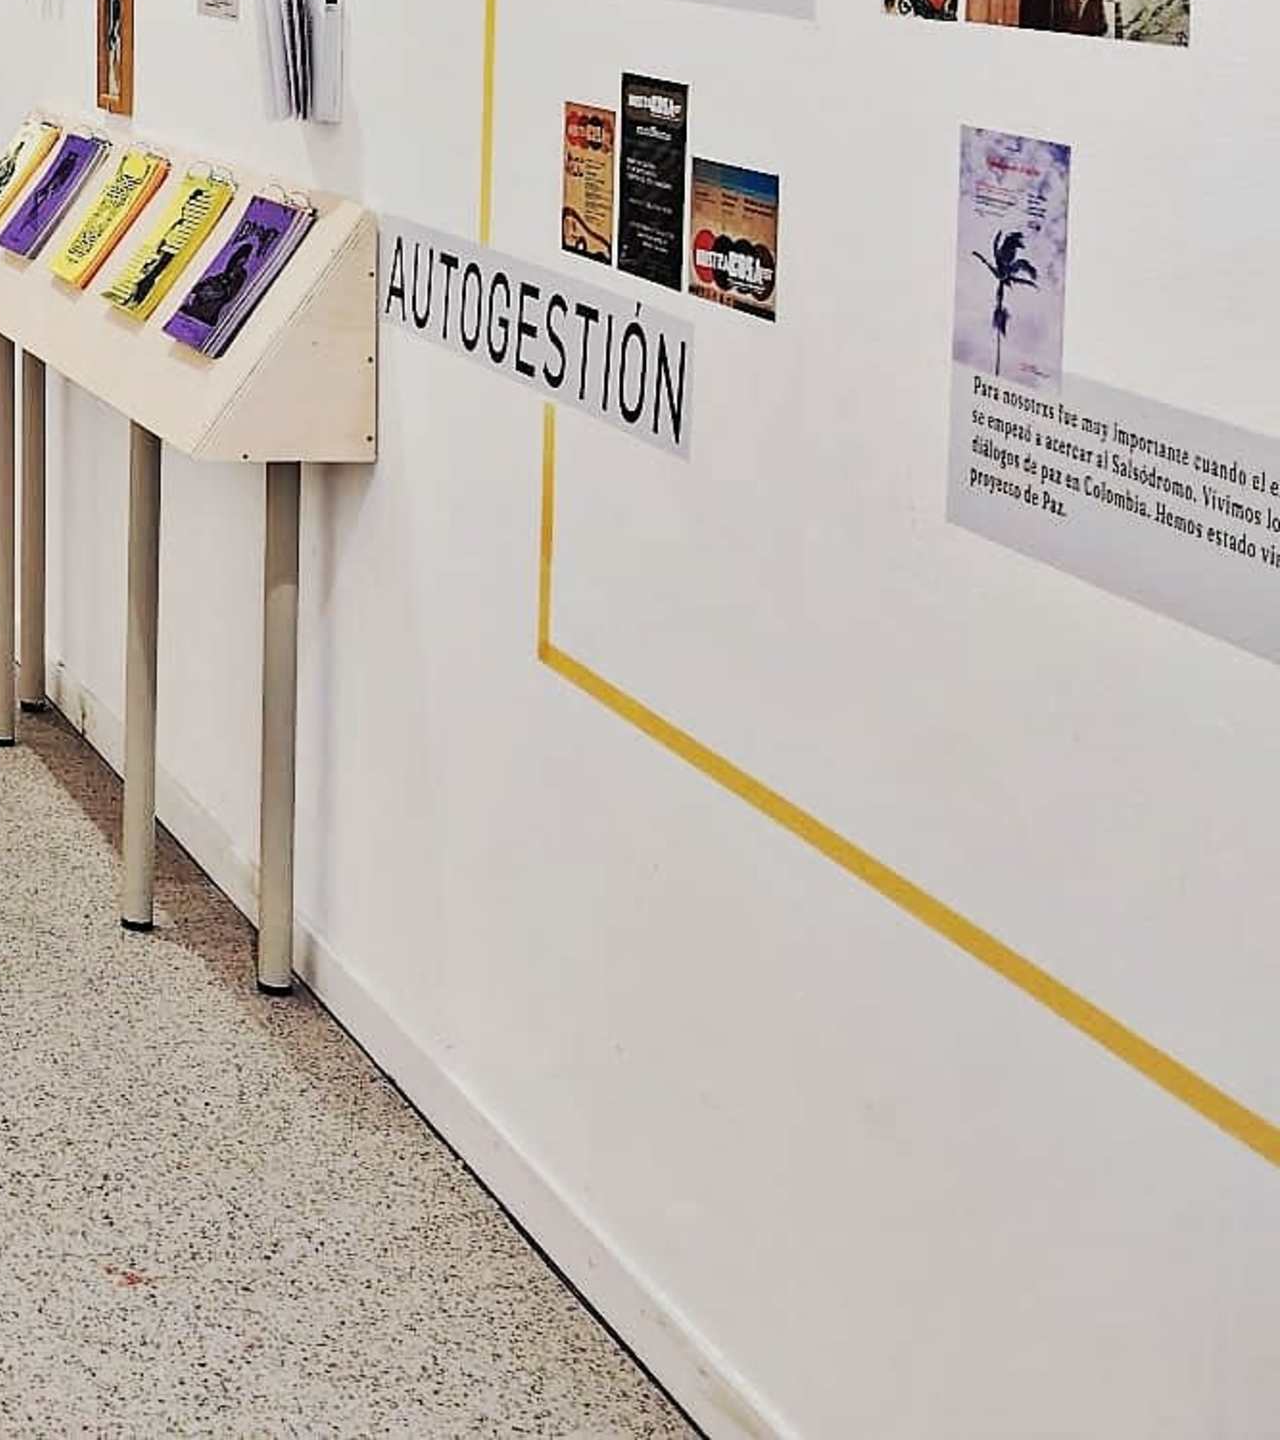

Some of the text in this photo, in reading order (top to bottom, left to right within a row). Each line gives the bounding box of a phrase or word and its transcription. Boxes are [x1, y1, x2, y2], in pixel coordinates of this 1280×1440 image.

[384, 232, 688, 445] AUTOGESTIÓN
[970, 466, 1021, 502] proyecto
[1024, 484, 1039, 507] de
[972, 408, 985, 424] se
[1045, 433, 1093, 465] acercar
[1112, 452, 1197, 504] Salsódromo.
[1202, 483, 1262, 526] Vivimos
[973, 375, 999, 401] Para
[1058, 403, 1078, 429] fue
[1082, 414, 1108, 443] muy
[1113, 421, 1190, 466] importante
[1194, 454, 1246, 487] cuando
[1253, 470, 1266, 493] el
[971, 434, 1020, 469] diálogos
[1023, 453, 1038, 476] de
[1041, 463, 1063, 486] paz
[1066, 471, 1080, 492] en
[1084, 474, 1152, 520] Colombia.
[1154, 501, 1203, 540] Hemos
[1207, 523, 1257, 558] estado
